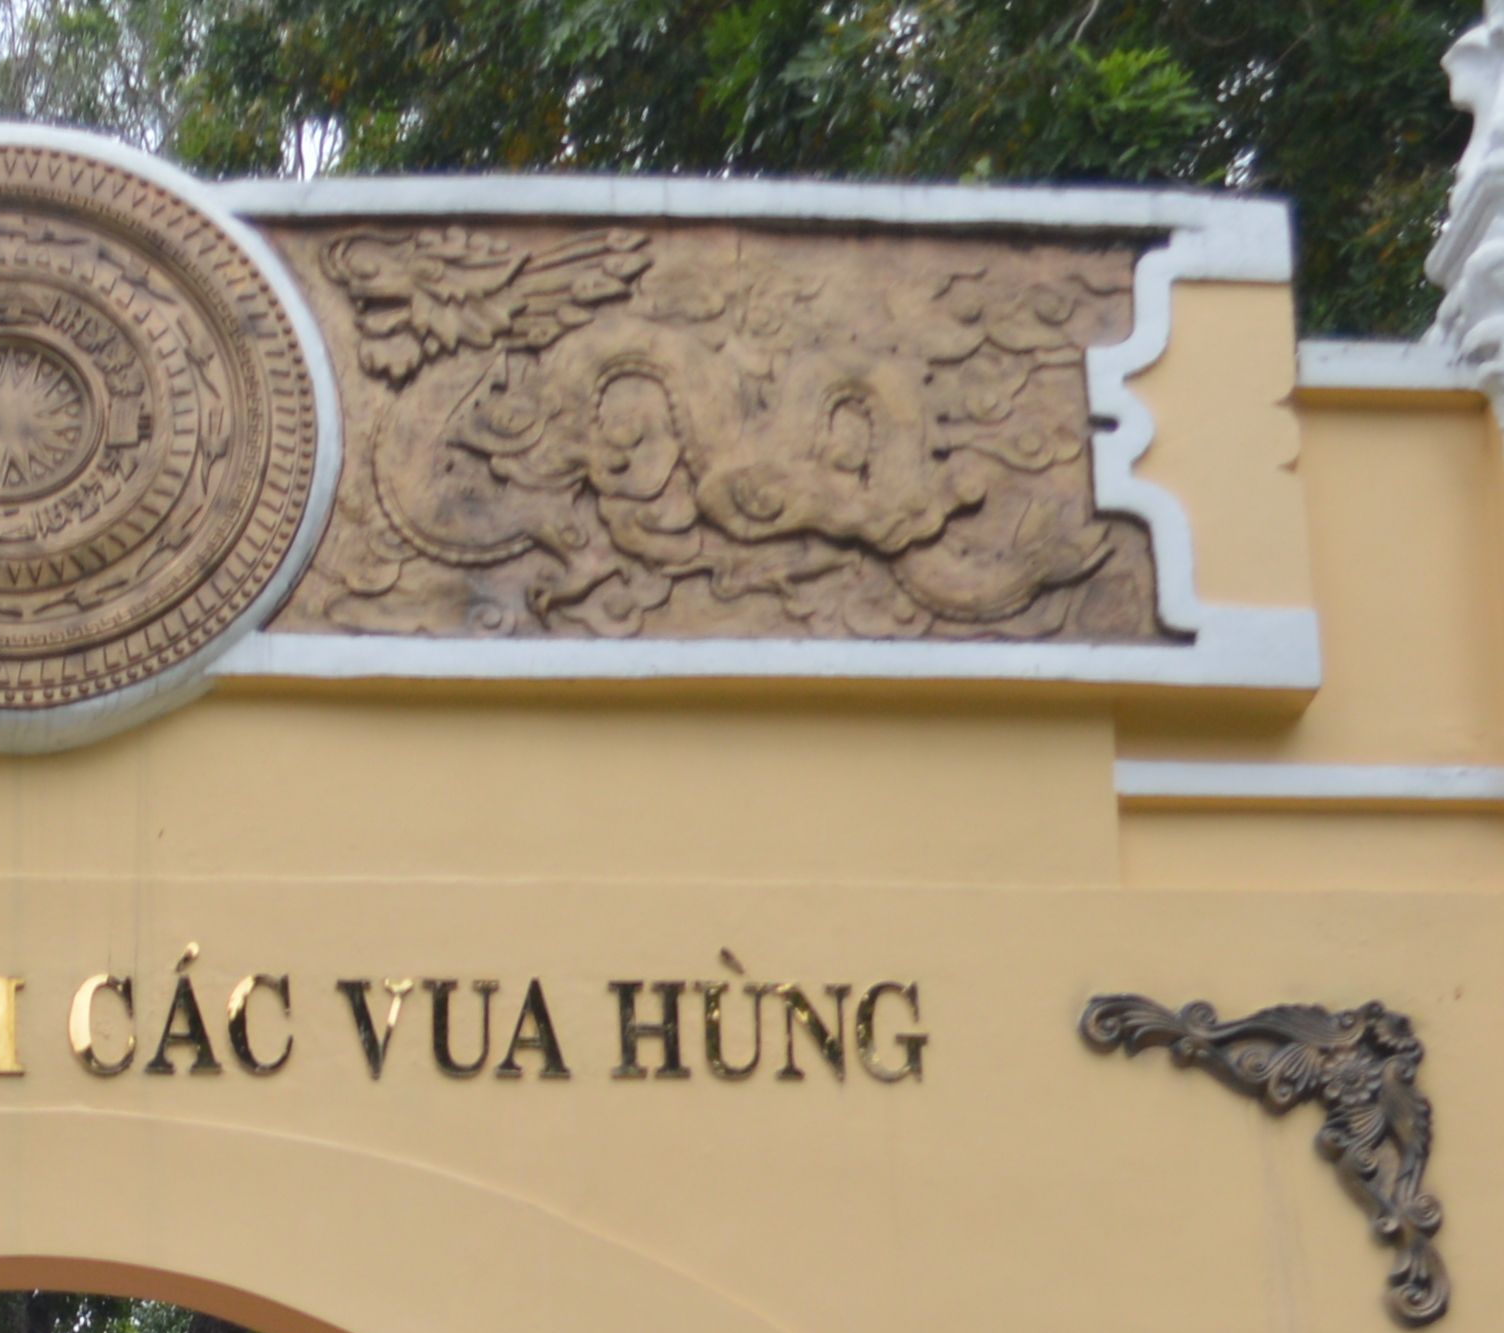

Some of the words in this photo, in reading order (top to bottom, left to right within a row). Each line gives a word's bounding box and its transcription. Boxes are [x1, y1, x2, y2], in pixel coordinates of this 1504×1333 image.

[68, 941, 294, 1076] CÁC
[336, 977, 571, 1080] VUA
[608, 947, 929, 1083] HÙNG
